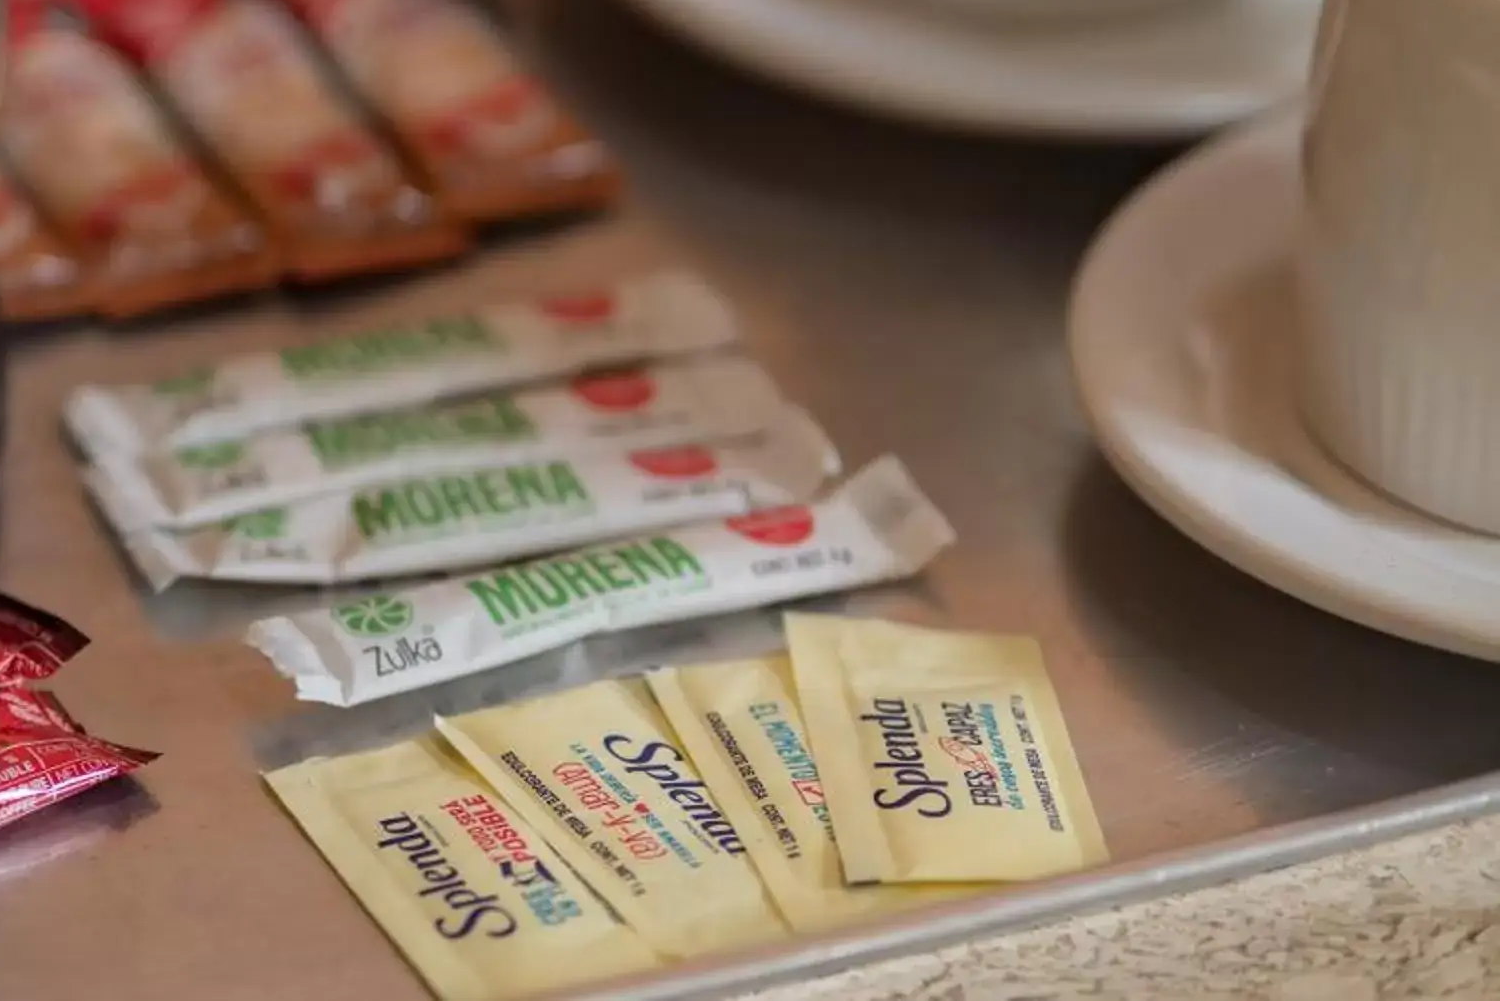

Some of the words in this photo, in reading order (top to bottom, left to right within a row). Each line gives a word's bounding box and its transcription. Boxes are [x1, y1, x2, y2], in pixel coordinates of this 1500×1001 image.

[353, 460, 589, 539] MORENA
[467, 536, 704, 626] MORENA
[362, 634, 443, 678] Zulka
[860, 697, 953, 818] Splenda
[941, 701, 983, 746] CAPAZ
[964, 769, 1003, 808] ERES
[377, 810, 517, 940] Splenda
